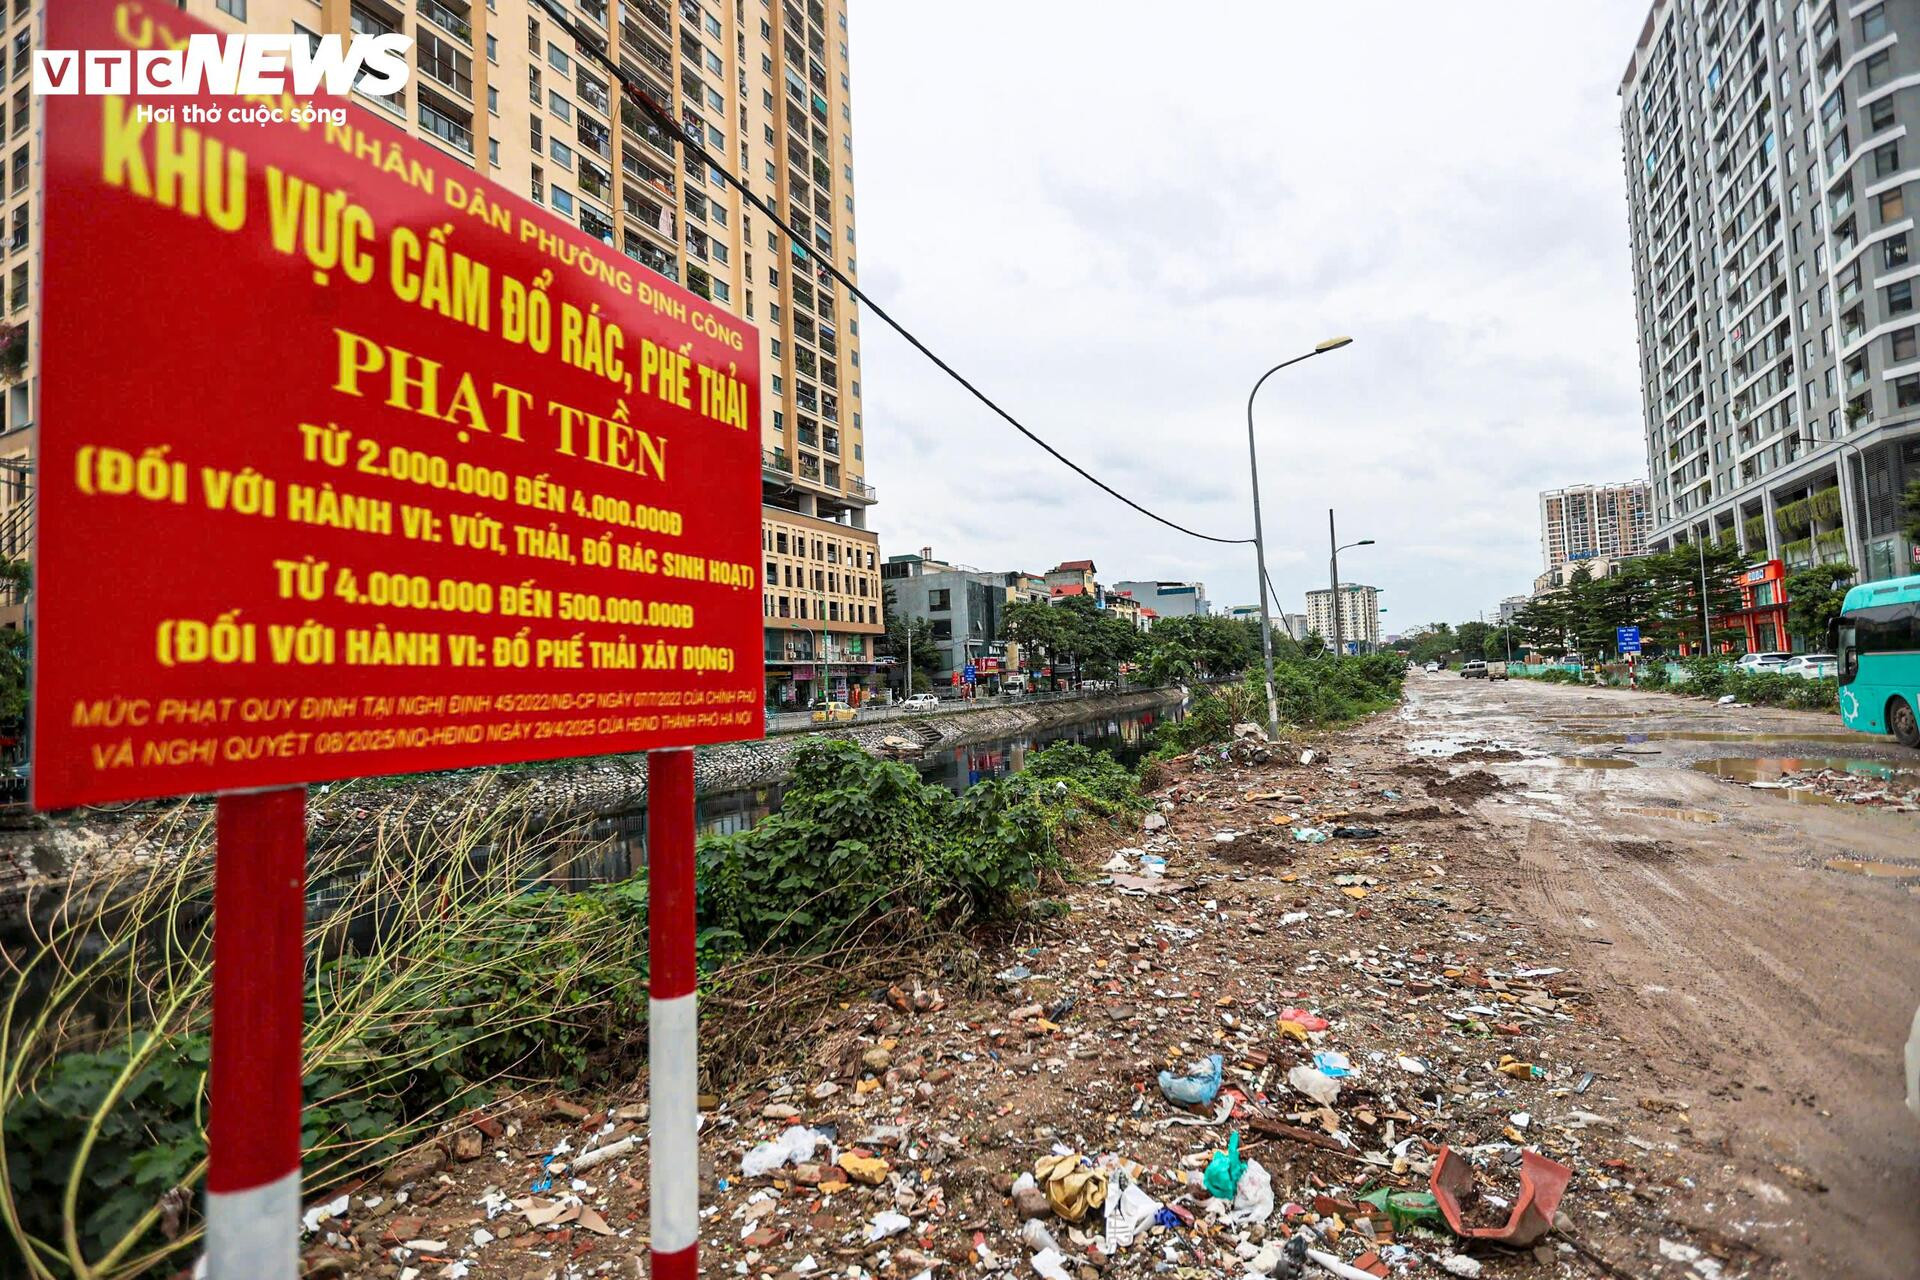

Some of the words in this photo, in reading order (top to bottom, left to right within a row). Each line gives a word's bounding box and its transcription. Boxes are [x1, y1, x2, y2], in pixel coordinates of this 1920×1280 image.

[103, 92, 246, 231] KHU
[266, 166, 374, 283] VỰC
[391, 227, 489, 331] CẤM
[501, 271, 552, 353] ĐỔ
[562, 303, 632, 393] RÁC,
[641, 339, 691, 409] PHẾ
[698, 361, 747, 430] THẢI
[324, 119, 434, 192] NHÂN
[445, 179, 510, 232] DÂN
[521, 219, 632, 294] PHƯỜNG
[639, 283, 686, 320] ĐỊNH
[691, 311, 742, 349] CÔNG
[334, 330, 532, 443] PHẠT
[549, 402, 666, 480] TIỀN
[76, 445, 186, 503] (ĐỐI
[202, 467, 275, 517] VỚI
[289, 483, 391, 534] HÀNH
[401, 505, 441, 542] VI:
[450, 512, 507, 555] VỨT,
[514, 526, 576, 564] THẢI,
[582, 533, 612, 567] ĐỔ
[618, 543, 657, 574] RÁC
[663, 552, 705, 580] SINH
[709, 560, 754, 589] HOẠT)
[299, 424, 351, 466] TỪ
[358, 440, 508, 500] 2.000.000
[515, 474, 565, 512] ĐẾN
[572, 490, 682, 536] 4.000.000Đ
[157, 609, 255, 666] (ĐỐI
[269, 619, 334, 664] VỚI
[346, 624, 440, 666] HÀNH
[447, 635, 486, 667] VI:
[493, 627, 530, 667] ĐỔ
[537, 634, 584, 668] PHẾ
[589, 635, 636, 669] THẢI
[642, 640, 677, 669] XÂY
[683, 646, 734, 675] DỰNG)
[274, 556, 328, 600] TỪ
[335, 568, 493, 614] 4.000.000
[500, 580, 552, 618] ĐẾN
[559, 592, 693, 628] 500.000.000Đ
[157, 699, 236, 726] PHẠT
[240, 698, 298, 722] QUY
[300, 696, 357, 722] ĐỊNH
[362, 695, 395, 720] TẠI
[397, 695, 446, 717] NGHỊ
[449, 695, 491, 716] ĐỊNH
